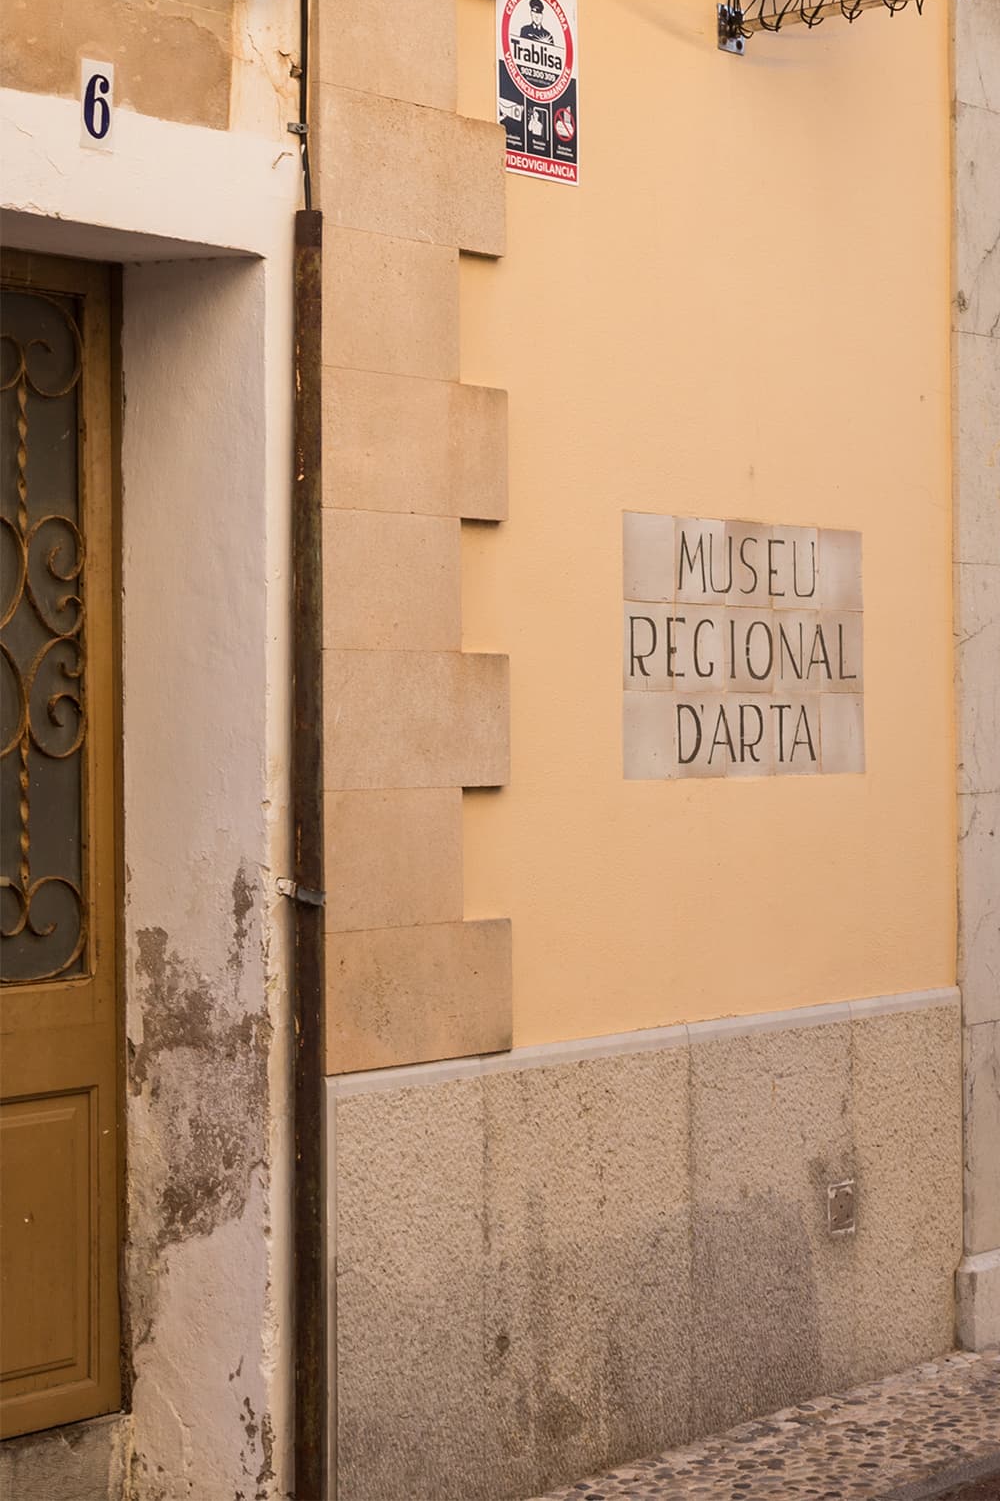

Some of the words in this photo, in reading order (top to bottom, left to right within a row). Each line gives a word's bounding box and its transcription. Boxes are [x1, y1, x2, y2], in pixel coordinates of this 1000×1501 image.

[505, 51, 535, 98] VIGILANCIA
[535, 66, 572, 100] PERMANENTE
[510, 38, 562, 71] Trablisa
[83, 73, 110, 140] 6
[506, 154, 576, 180] IDEOVIGILANCIA
[677, 530, 816, 598] MUSEU
[629, 615, 857, 681] REGIONAL
[676, 703, 817, 765] D'ARTA
